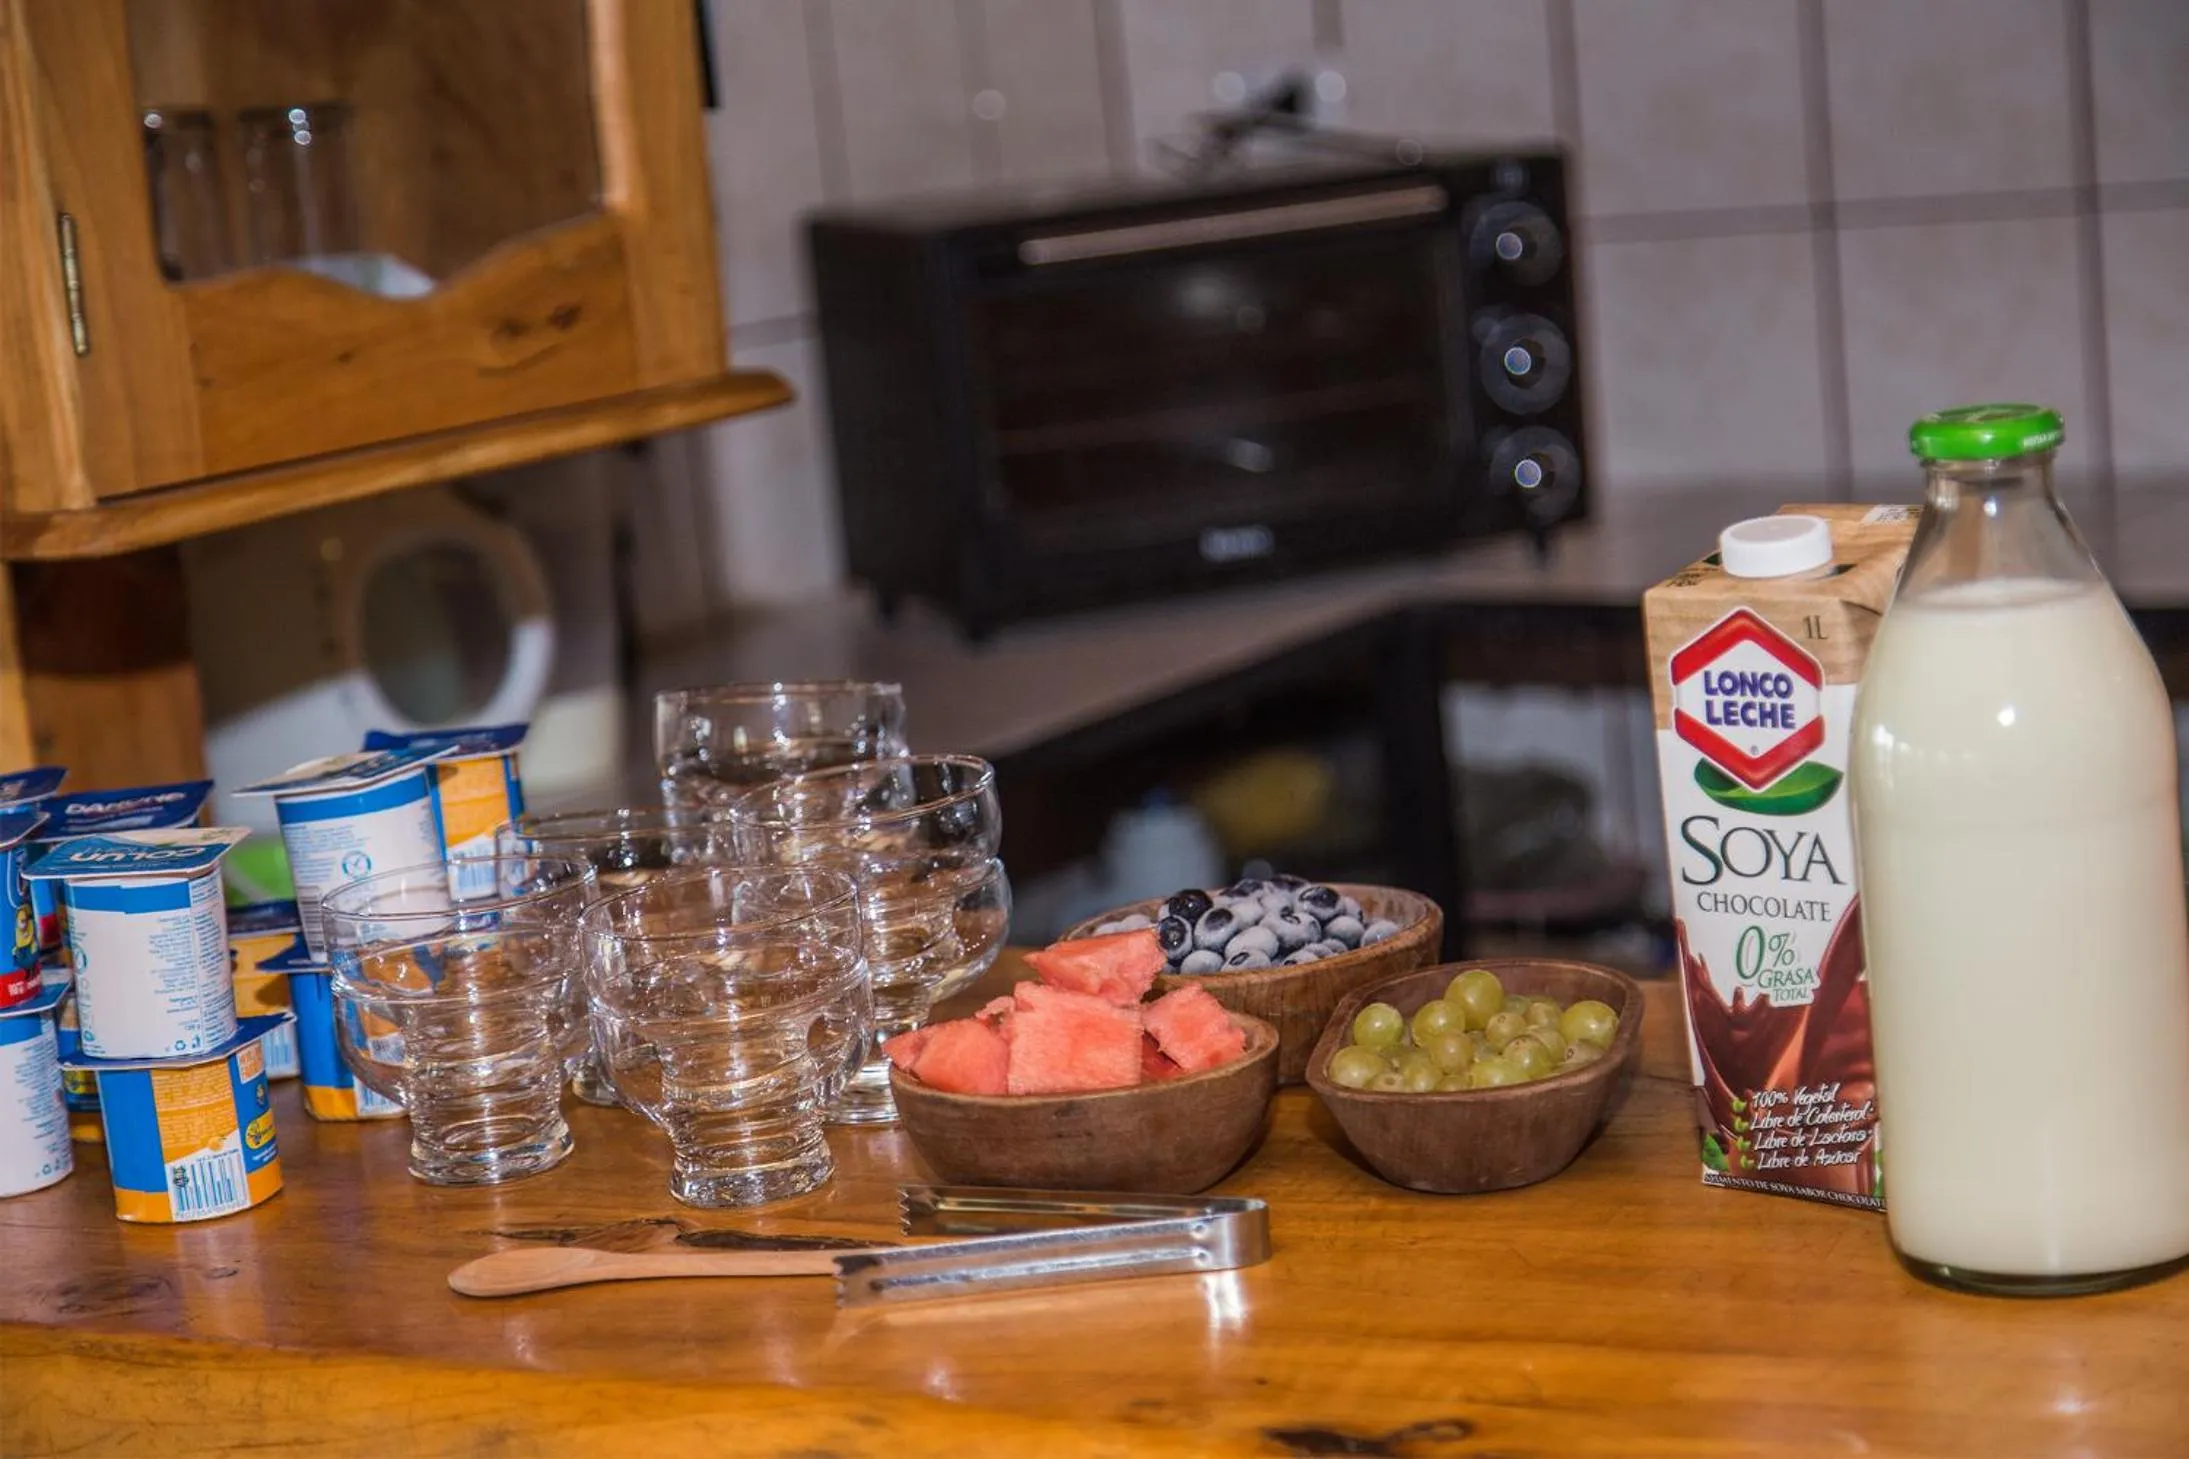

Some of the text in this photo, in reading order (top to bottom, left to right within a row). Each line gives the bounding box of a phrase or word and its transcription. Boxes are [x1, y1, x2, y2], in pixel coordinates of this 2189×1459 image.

[1803, 614, 1828, 640] 1L
[1703, 670, 1794, 699] LONCO
[1705, 700, 1796, 729] LECHE
[1680, 815, 1847, 885] SOYA
[1697, 891, 1832, 922] CHOCOLATE
[1736, 925, 1795, 979] 0%
[1758, 968, 1815, 989] GRASA
[1774, 988, 1809, 1003] TOTAL
[1752, 1083, 1840, 1115] 100% Vegetal
[1750, 1109, 1785, 1130] Libre
[1787, 1107, 1803, 1127] de
[1754, 1131, 1788, 1150] Libre
[1791, 1127, 1806, 1147] de
[1758, 1150, 1791, 1169] Libre
[1794, 1148, 1810, 1166] de
